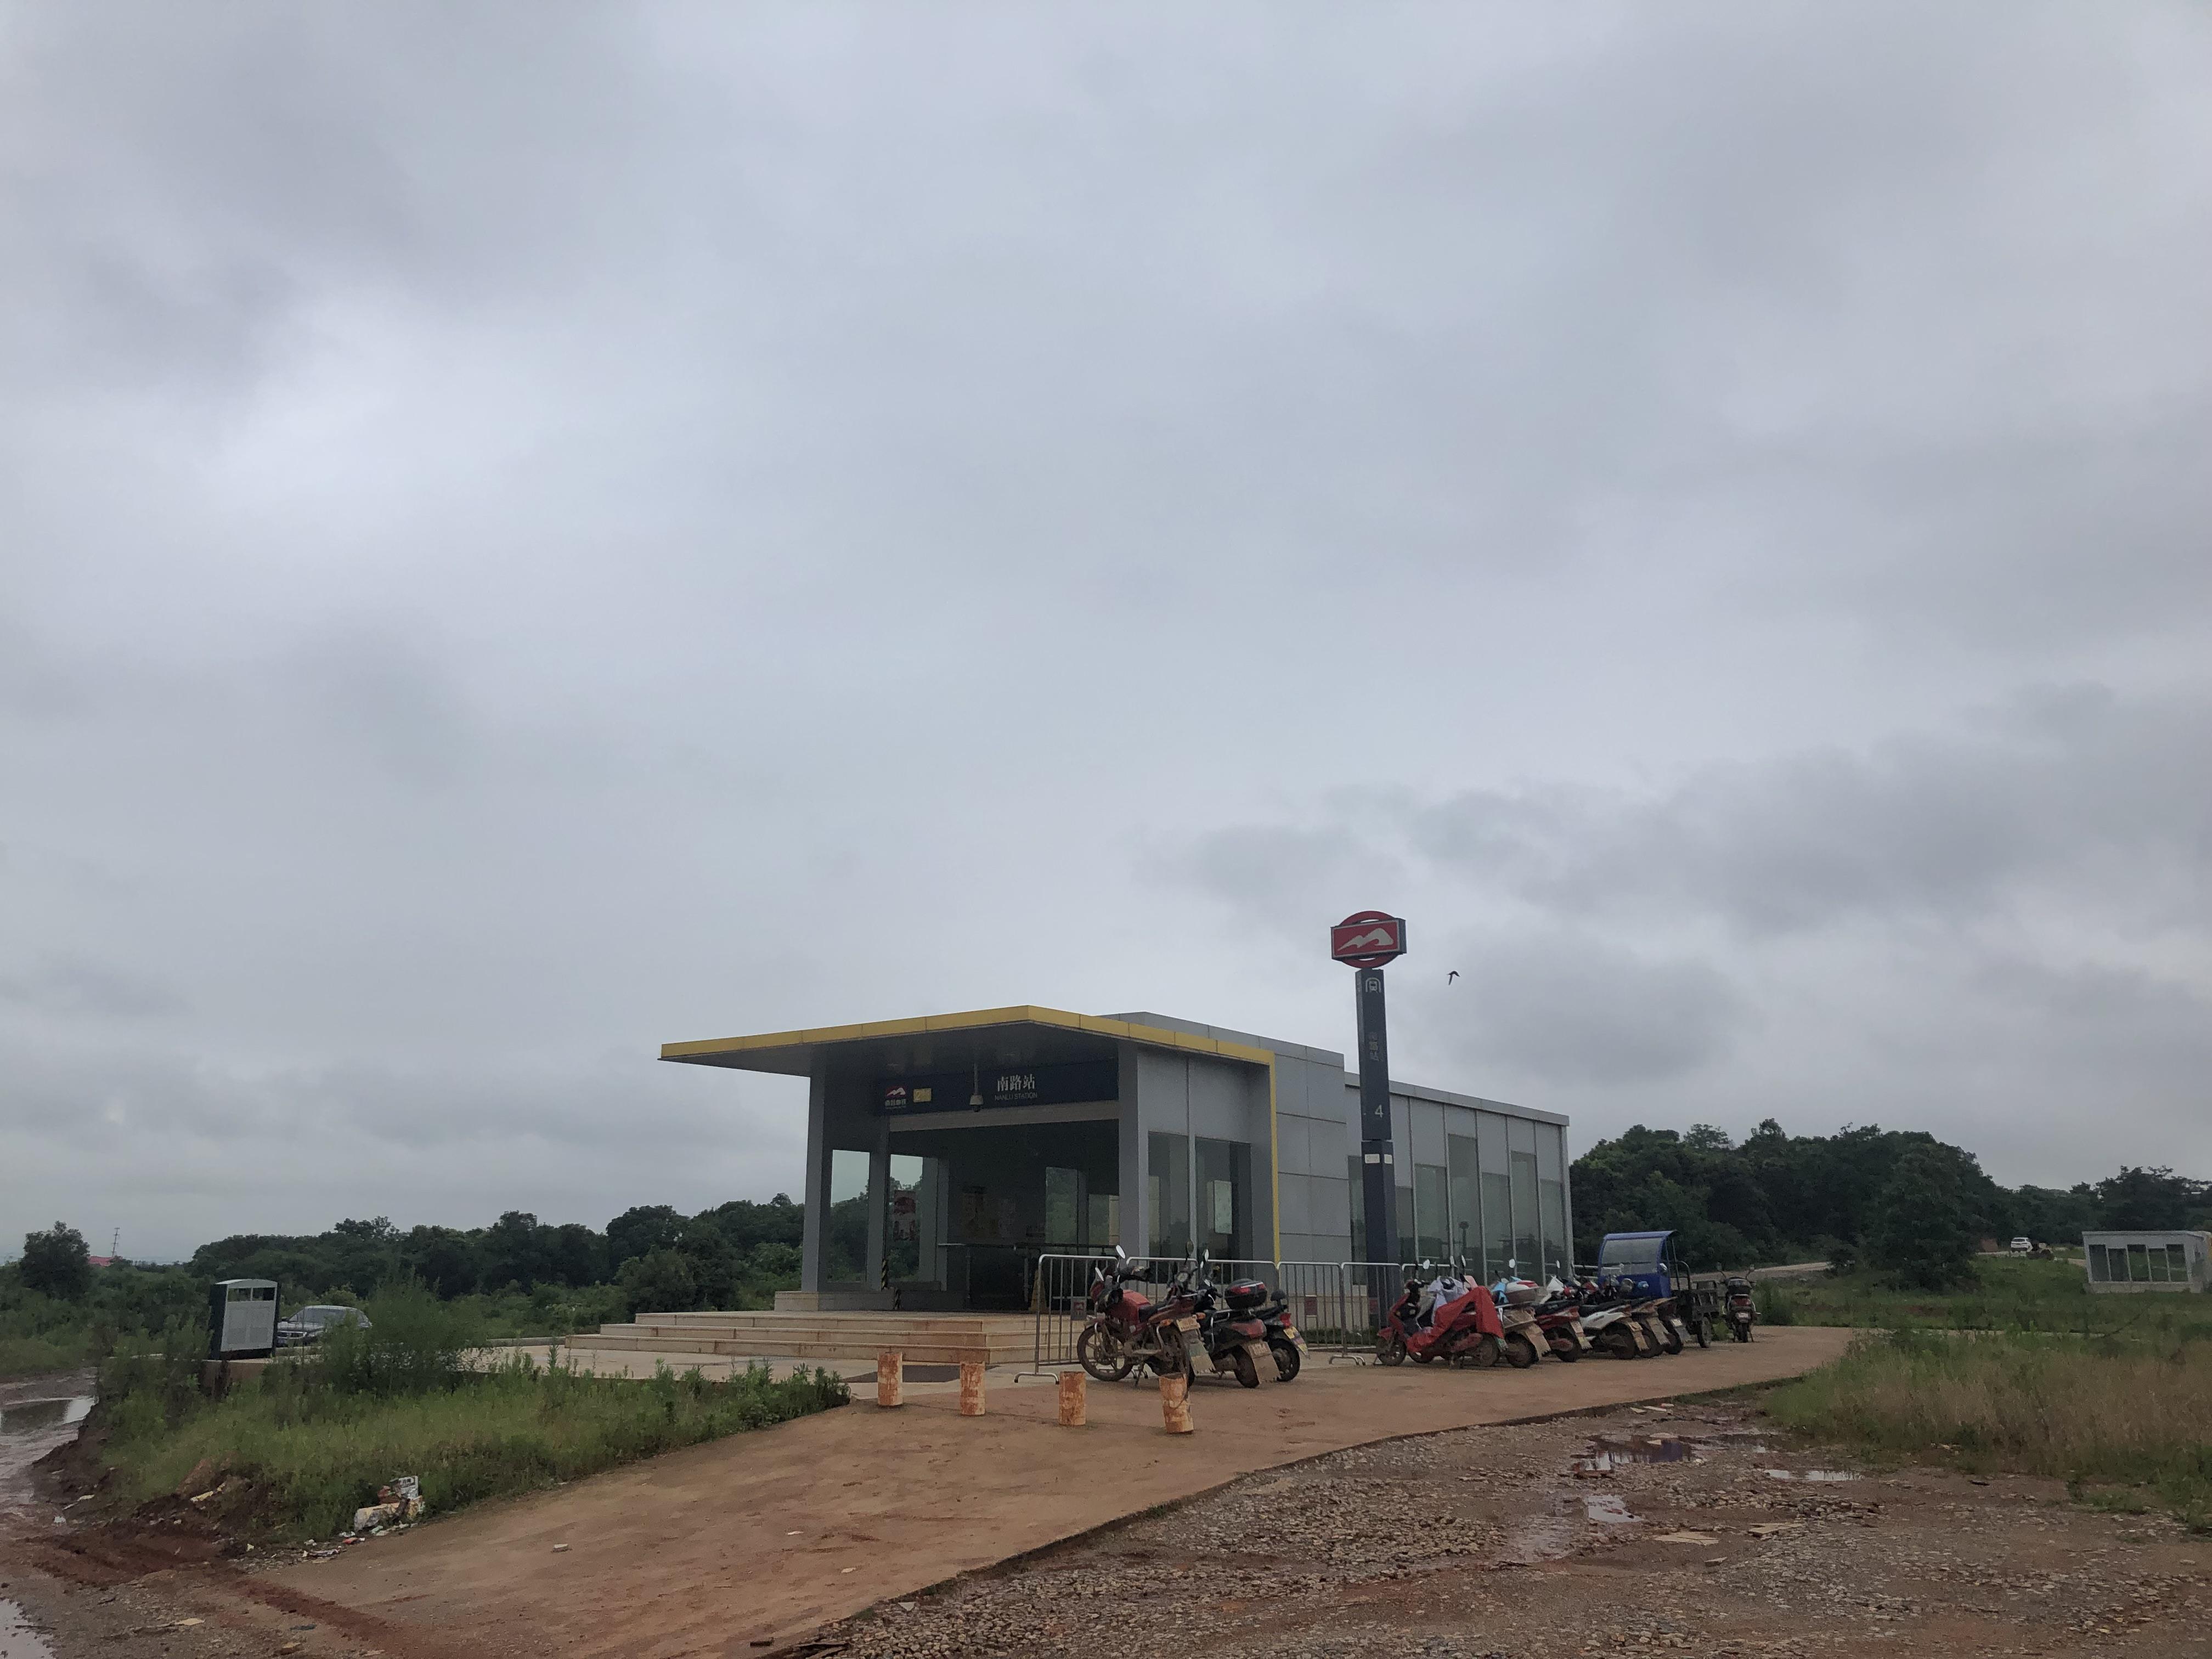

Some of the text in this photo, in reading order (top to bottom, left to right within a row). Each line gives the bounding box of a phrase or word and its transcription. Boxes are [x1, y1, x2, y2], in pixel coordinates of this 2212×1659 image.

[997, 1074, 1035, 1092] 南路站
[1374, 1104, 1384, 1118] 4
